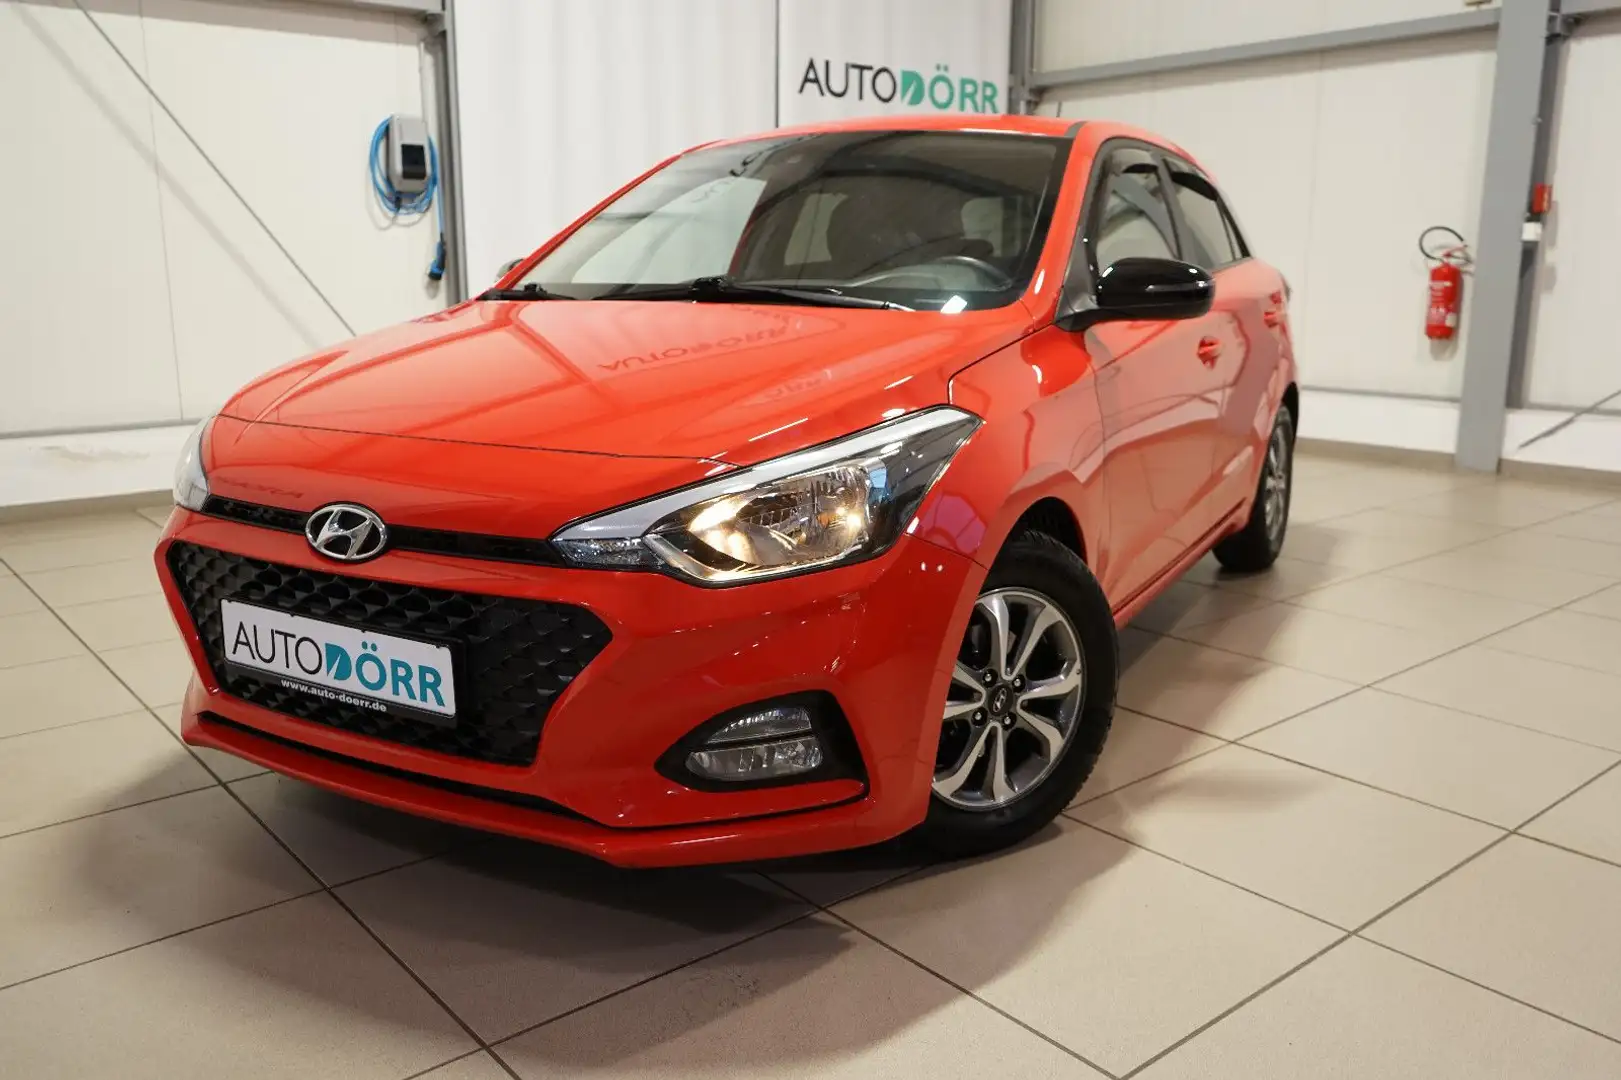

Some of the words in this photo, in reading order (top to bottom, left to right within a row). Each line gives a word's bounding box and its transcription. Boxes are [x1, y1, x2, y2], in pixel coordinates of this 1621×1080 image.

[797, 57, 999, 114] AUTODÖRR
[232, 621, 445, 707] AUTODÖRR
[281, 679, 387, 712] www.auto-doerr.de
